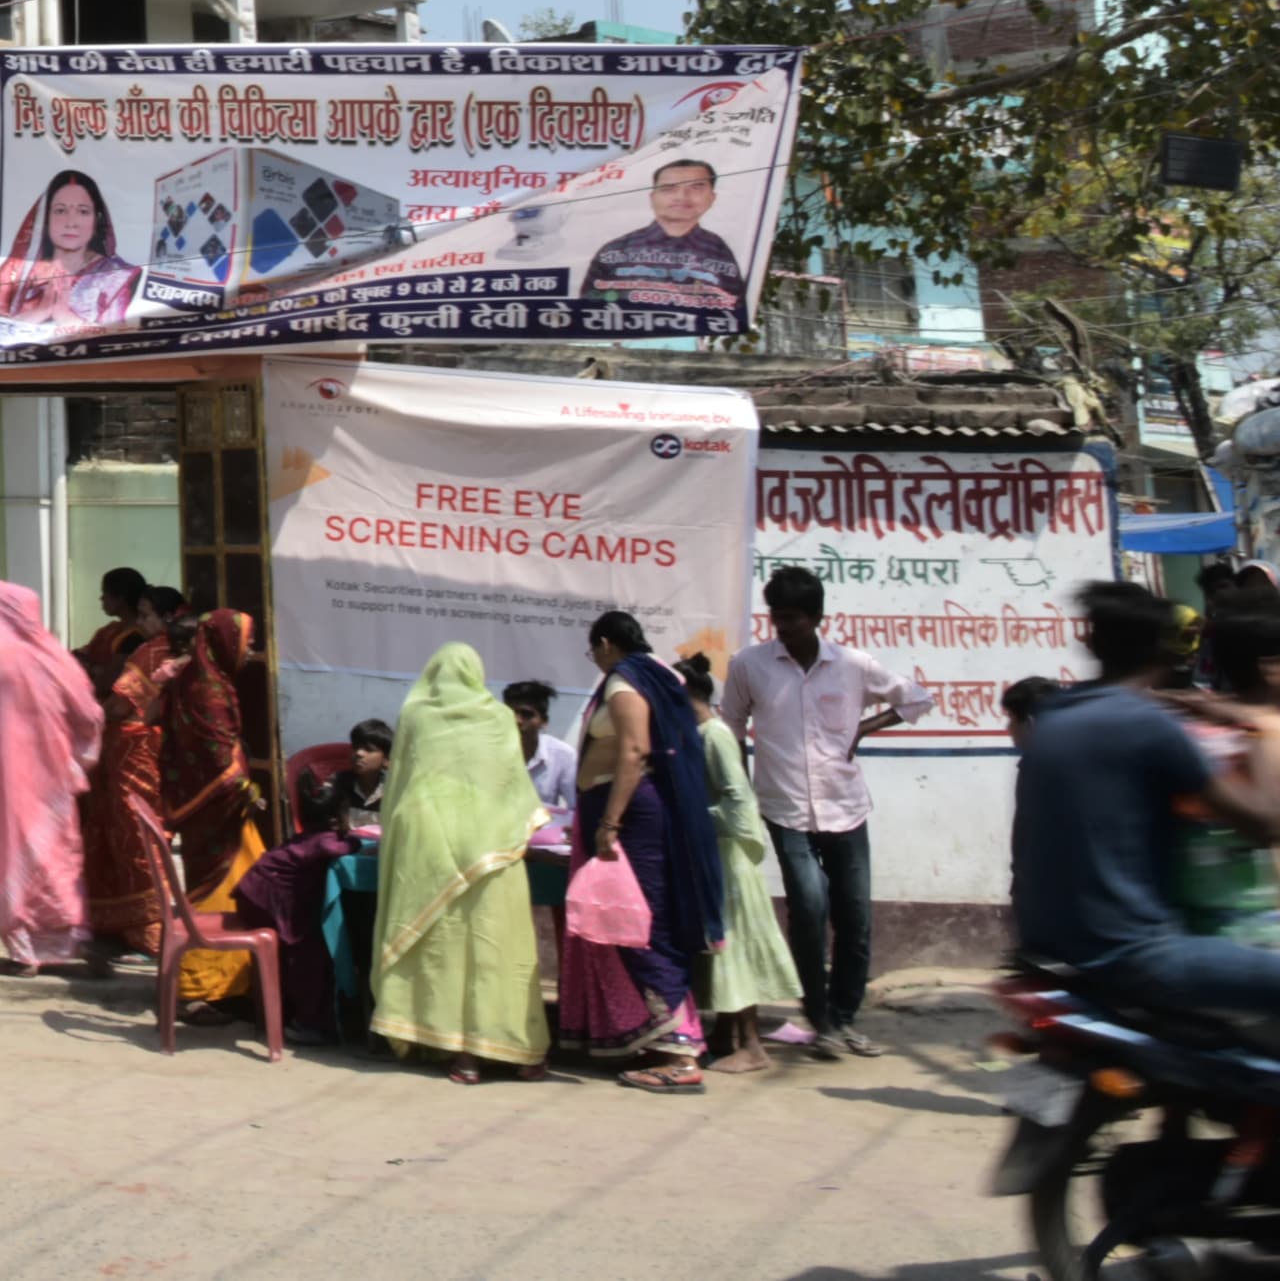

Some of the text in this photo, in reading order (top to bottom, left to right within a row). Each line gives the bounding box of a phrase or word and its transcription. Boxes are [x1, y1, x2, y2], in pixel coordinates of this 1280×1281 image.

[4, 53, 56, 73] आप
[69, 50, 107, 72] की
[115, 50, 175, 72] सेवा
[181, 48, 218, 72] ही
[225, 48, 313, 72] हमारी
[324, 53, 432, 73] पहचान
[489, 48, 605, 72] विकाश
[617, 48, 724, 72] आपके
[51, 94, 107, 150] शुल्क
[116, 85, 172, 140] आँख
[179, 84, 211, 140] की
[218, 84, 319, 142] चिकित्सा
[327, 85, 402, 142] आपके
[407, 97, 455, 151] द्वार
[463, 91, 523, 156] (एक
[528, 85, 646, 153] दिवसीय)
[407, 165, 547, 195] अत्याधुनिक
[397, 282, 410, 297] 9
[414, 276, 445, 296] बजे
[448, 274, 468, 295] से
[471, 278, 485, 294] 2
[490, 273, 522, 293] बजे
[524, 275, 559, 292] तक
[289, 307, 370, 334] पार्षद
[380, 302, 460, 336] कुन्ती
[471, 301, 528, 330] देवी
[539, 302, 572, 329] के
[581, 301, 699, 332] सौजन्य
[683, 437, 732, 453] kotak
[416, 482, 583, 521] FREE EYE
[791, 453, 896, 541] ज्योति
[897, 455, 1107, 543] इलेक्ट्रॉनिक्स
[325, 514, 677, 568] SCREENING CAMPS
[325, 578, 360, 593] Kotak
[363, 580, 424, 599] Securities
[425, 585, 479, 605] partners
[482, 591, 508, 605] with
[511, 592, 559, 609] Akhand
[561, 596, 594, 615] Jyoti
[332, 598, 345, 611] to
[347, 599, 396, 616] support
[398, 603, 423, 617] free
[425, 607, 448, 621] eye
[450, 607, 511, 626] screening
[513, 613, 556, 629] camps
[557, 614, 576, 628] for
[834, 611, 915, 649] आसान
[917, 599, 1001, 650] मासिक
[1002, 603, 1068, 650] किस्तों
